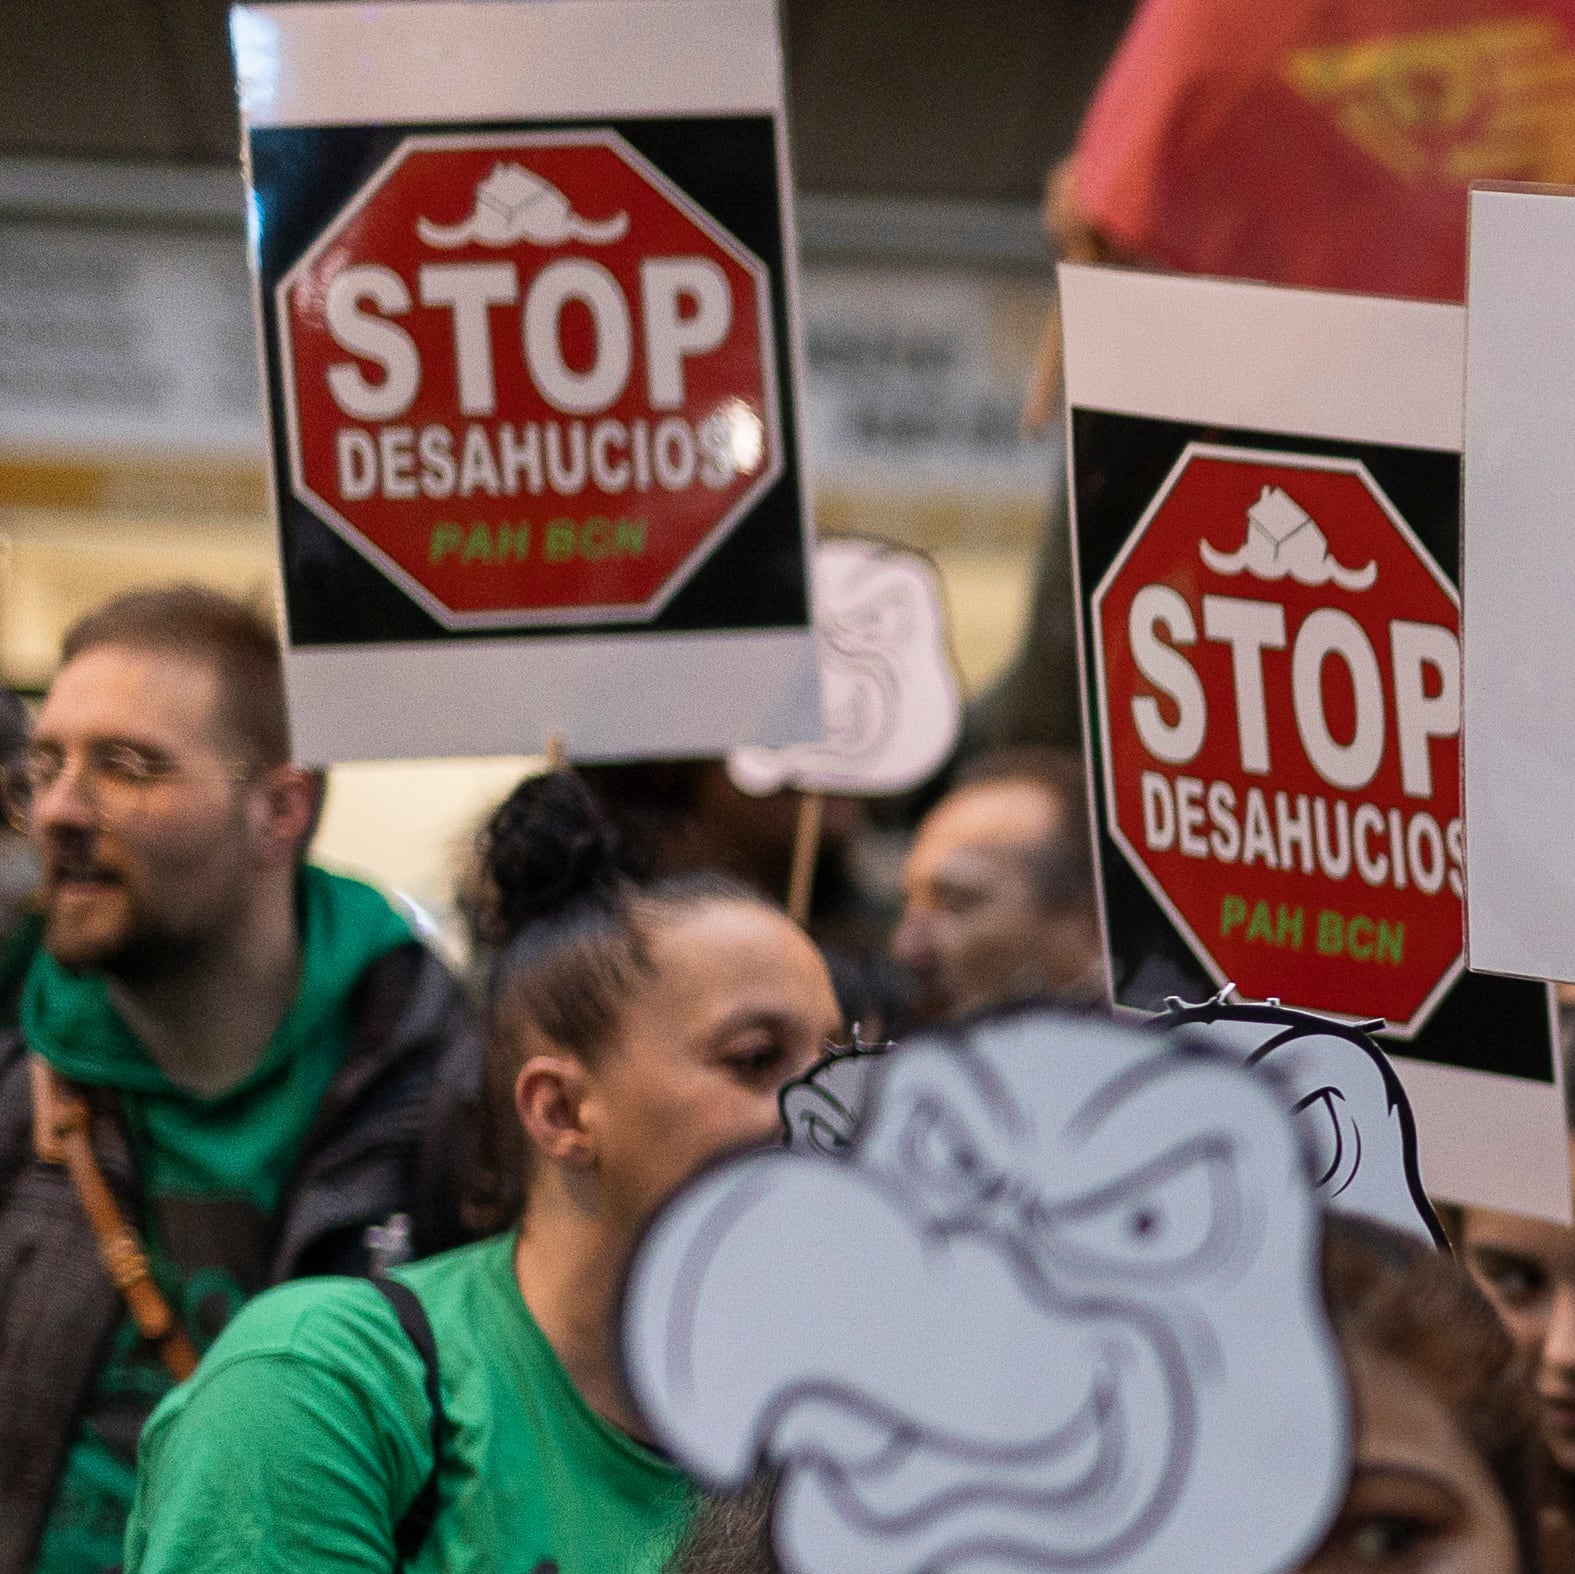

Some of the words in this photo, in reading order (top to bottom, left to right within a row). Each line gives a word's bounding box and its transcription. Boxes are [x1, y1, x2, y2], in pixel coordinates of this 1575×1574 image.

[326, 257, 733, 422] STOP
[335, 417, 739, 501] DESAHUCIOS
[430, 520, 530, 566] PAH
[545, 516, 647, 562] BCN
[1128, 584, 1462, 797] STOP
[1220, 894, 1304, 948] PAH
[1316, 908, 1404, 967] BCN
